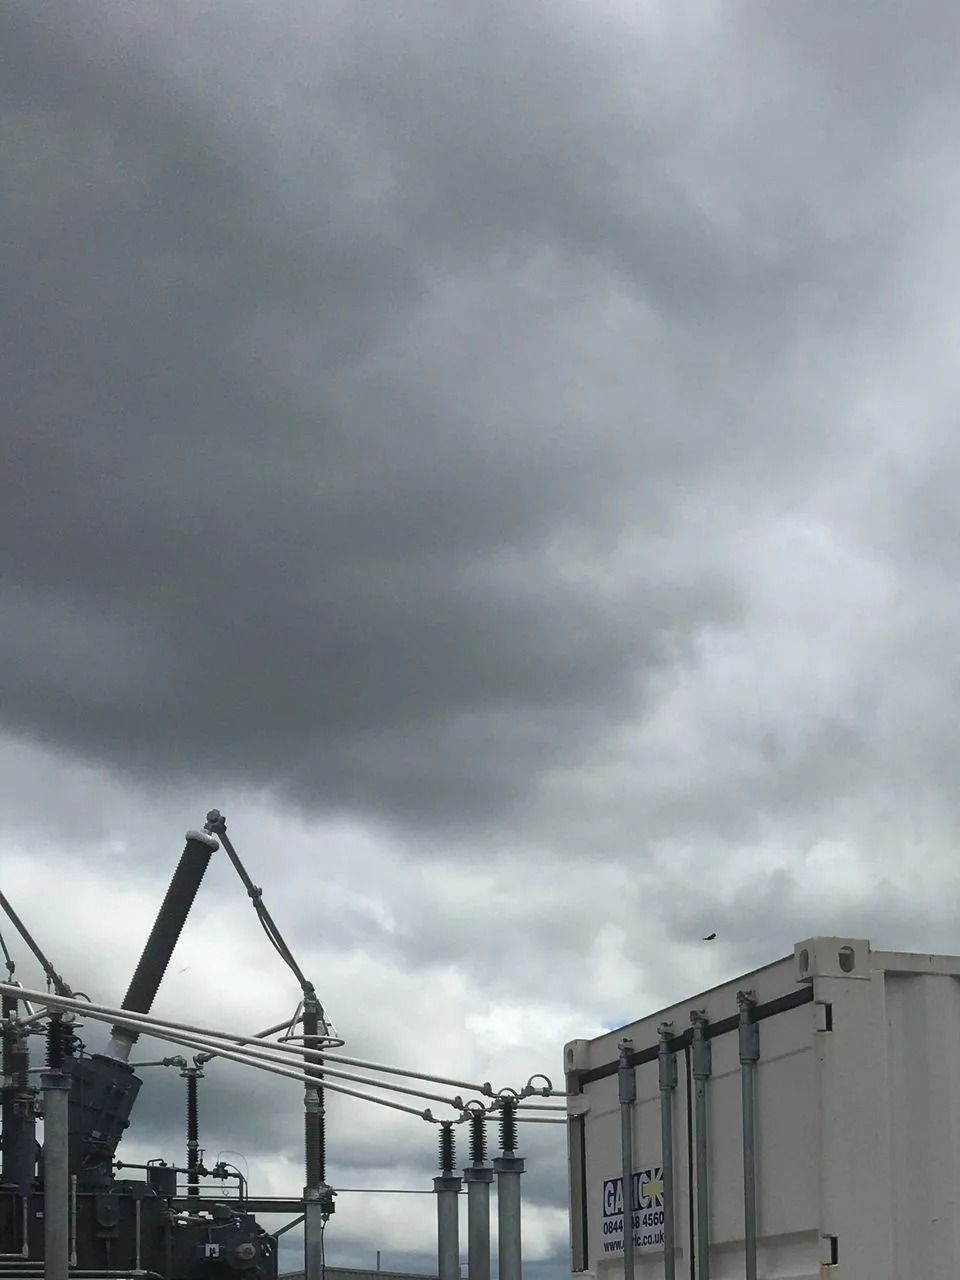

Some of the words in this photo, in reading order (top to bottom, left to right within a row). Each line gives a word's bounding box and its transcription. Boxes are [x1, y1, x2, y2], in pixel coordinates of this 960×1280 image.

[604, 1173, 650, 1215] GAIC
[603, 1219, 624, 1235] 0844
[643, 1211, 665, 1227] 4560
[604, 1230, 665, 1252] www.ric.co.uk
